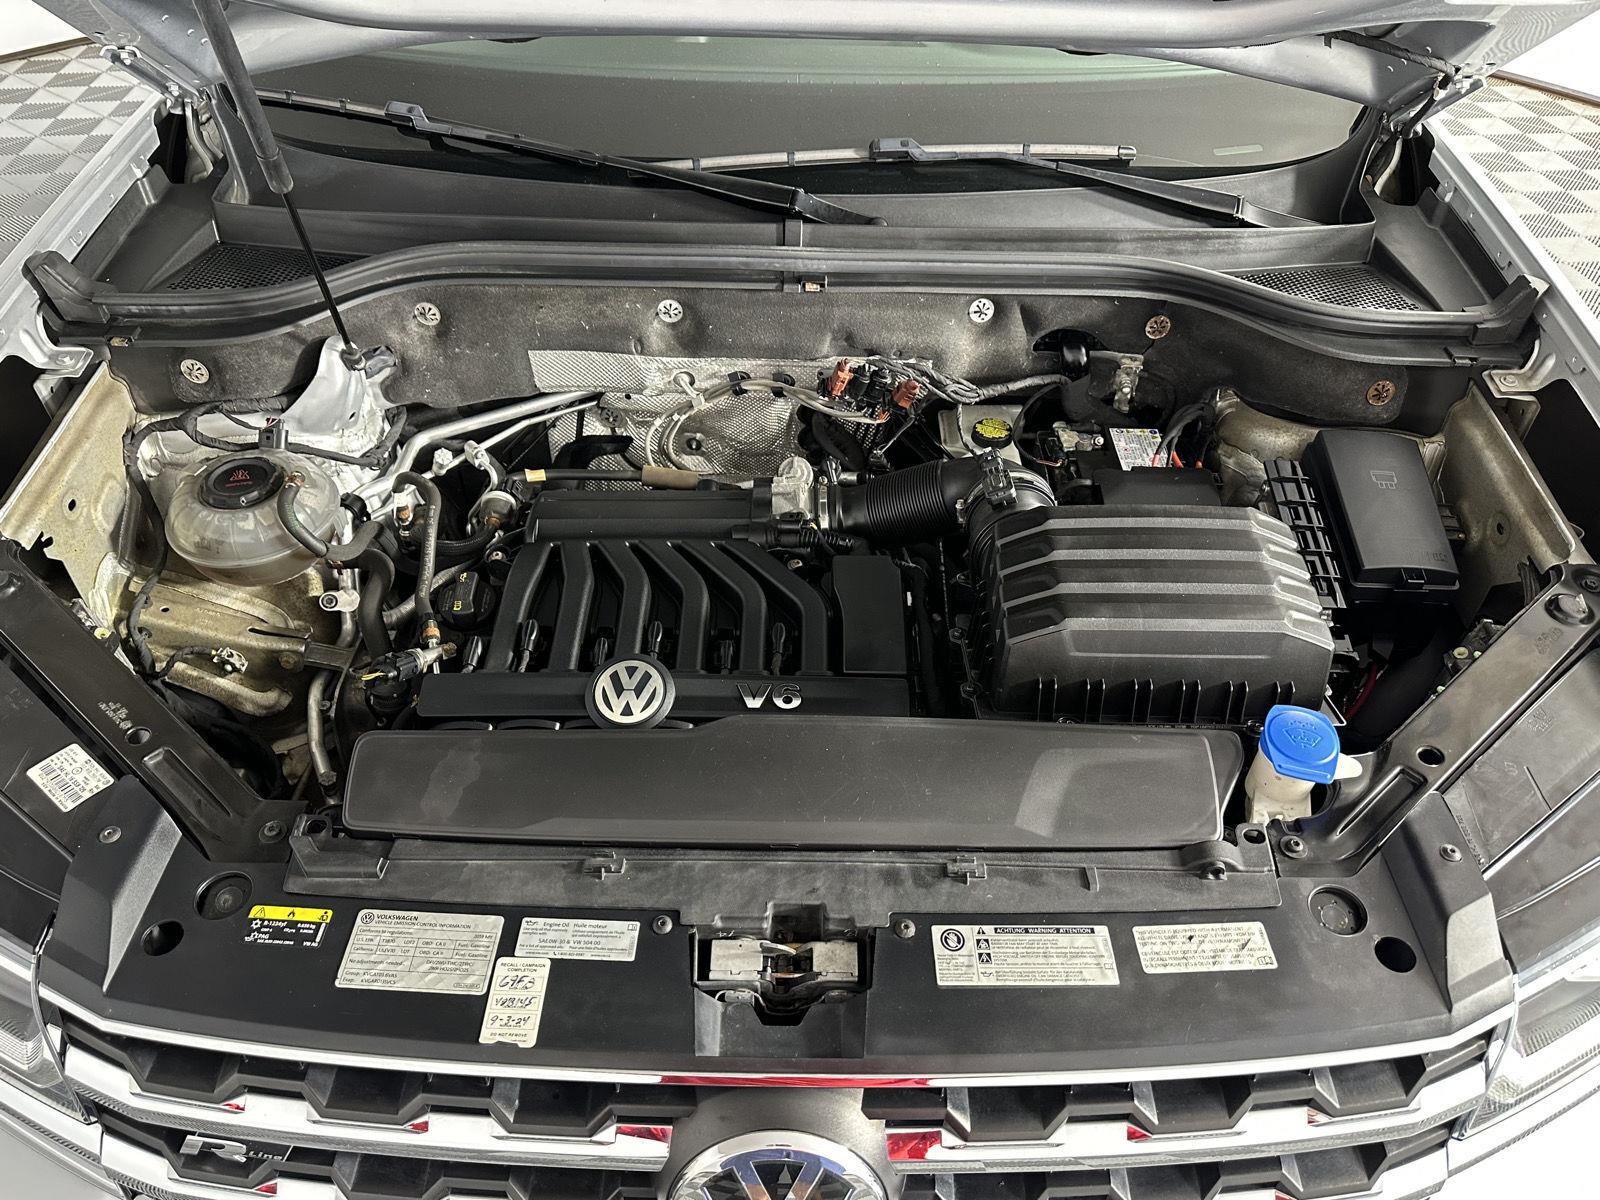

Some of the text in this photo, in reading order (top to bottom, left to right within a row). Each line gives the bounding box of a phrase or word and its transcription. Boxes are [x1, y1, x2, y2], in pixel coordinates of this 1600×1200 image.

[736, 682, 802, 710] V6
[180, 1134, 282, 1162] R Line
